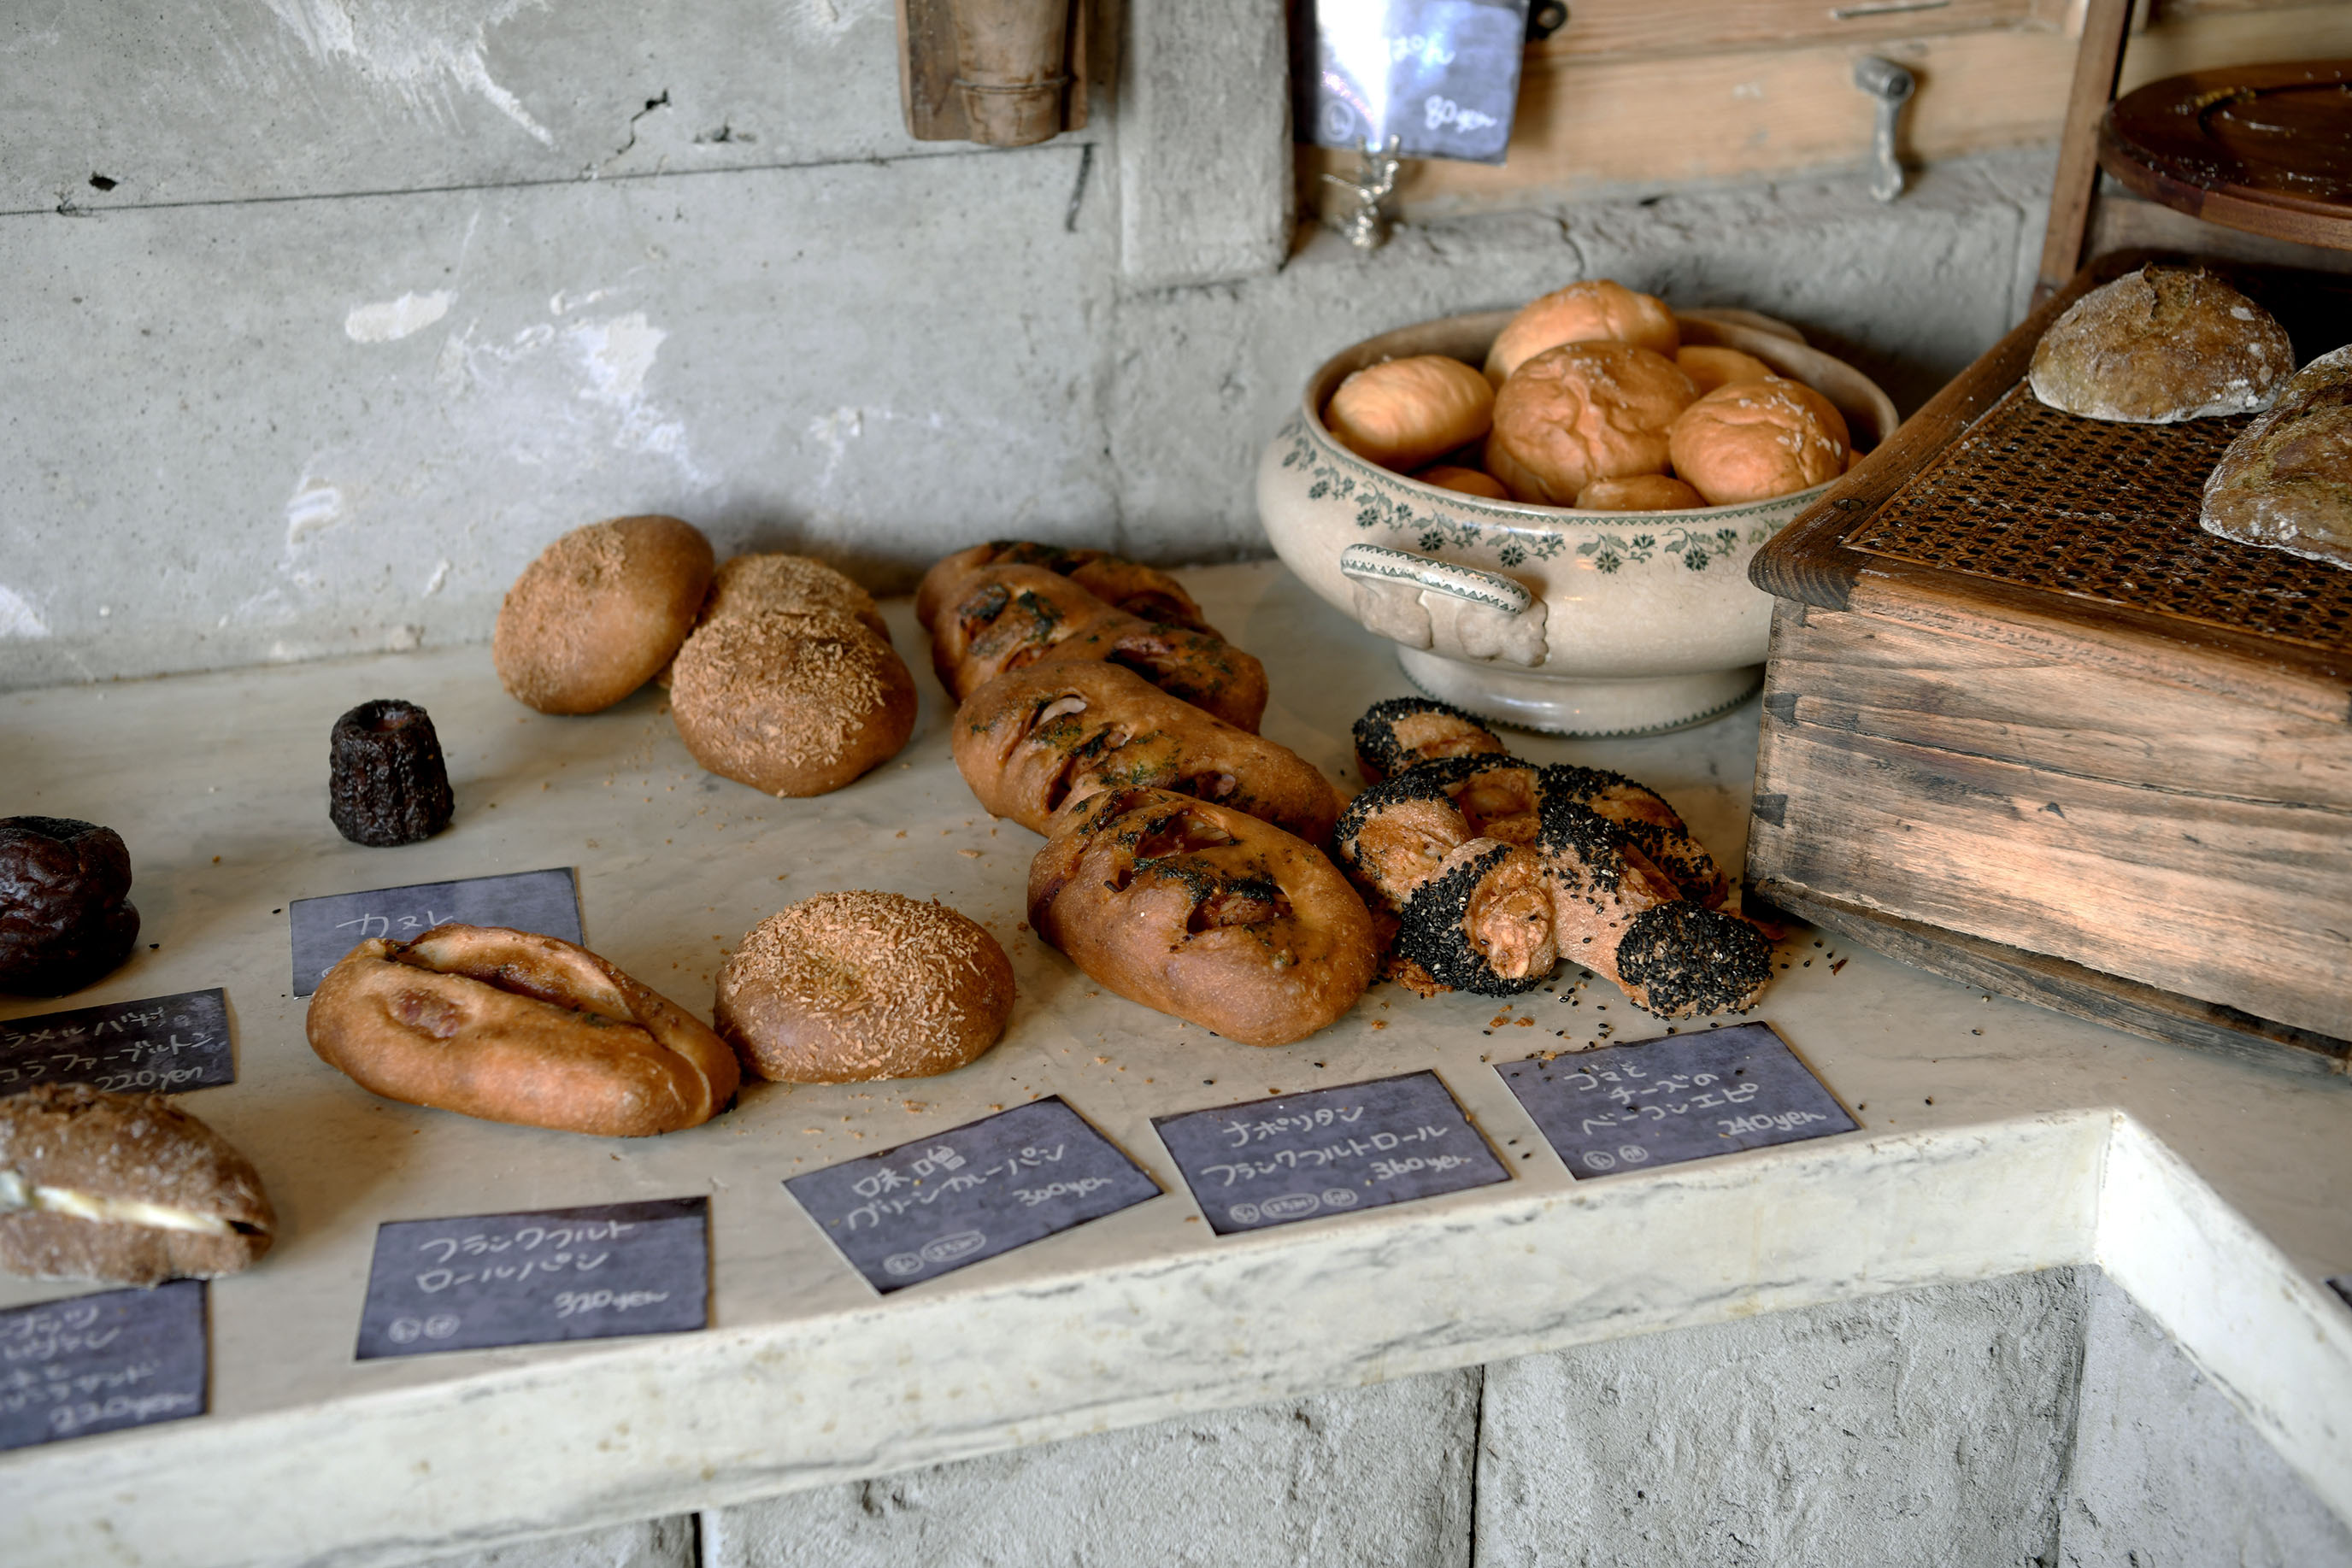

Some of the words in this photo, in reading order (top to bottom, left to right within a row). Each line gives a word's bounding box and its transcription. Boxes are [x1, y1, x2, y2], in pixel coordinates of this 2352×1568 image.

[336, 910, 454, 937] カヌレ
[95, 1066, 203, 1092] 220yen
[1608, 1073, 1720, 1104] チーズの
[1222, 1106, 1365, 1148] ナポリタン
[1583, 1083, 1759, 1135] ベーコンエピ
[1718, 1110, 1826, 1135] 240yen
[852, 1144, 966, 1197] 味噌
[1202, 1125, 1449, 1186] フランクフルトロール
[1370, 1154, 1471, 1181] 360yen
[847, 1144, 1065, 1231] グリーンカレーパン
[1013, 1177, 1114, 1207] 300yen
[419, 1219, 635, 1263] フランクフルト
[415, 1251, 609, 1294] ロールパン
